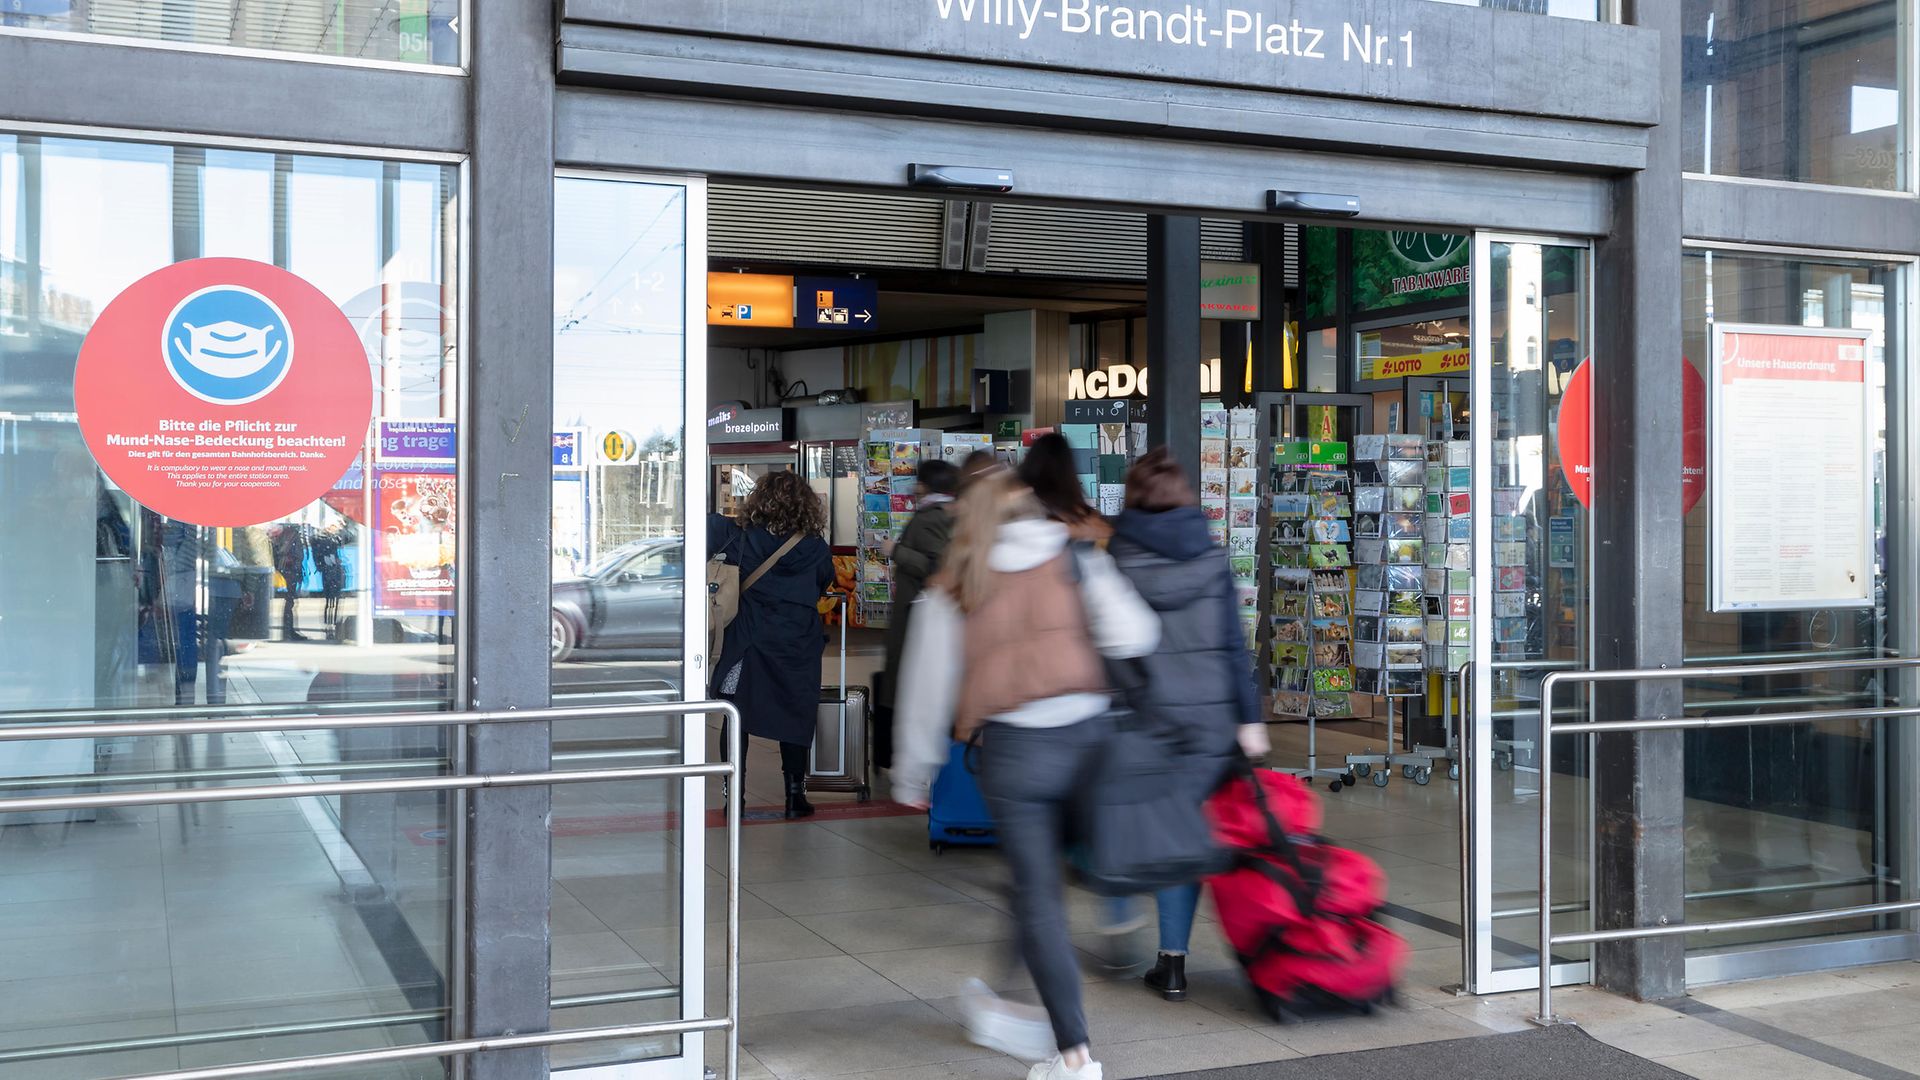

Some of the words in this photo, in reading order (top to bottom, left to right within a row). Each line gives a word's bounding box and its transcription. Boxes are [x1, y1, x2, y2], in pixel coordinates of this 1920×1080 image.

[935, 0, 1325, 58] Willy-Brandt-Platz
[1343, 22, 1412, 67] Nr.1
[1392, 265, 1470, 294] TABAKWARE
[1393, 359, 1422, 373] LOTTO
[1453, 353, 1470, 366] LOT
[1737, 357, 1771, 369] Unsere
[1772, 359, 1836, 373] Hausordnung
[1075, 406, 1119, 417] FINO
[159, 419, 195, 431] Bitte
[198, 420, 221, 432] die
[225, 420, 271, 432] Pflicht
[274, 423, 297, 432] zur
[725, 421, 779, 434] brezelpoint
[106, 434, 274, 449] Mund-Nase-Bedeckung
[277, 435, 346, 447] beachten!
[128, 450, 146, 458] Dies
[147, 450, 161, 459] gilt
[162, 450, 174, 458] für
[175, 450, 191, 458] den
[192, 451, 230, 459] gesamten
[231, 451, 298, 459] Bahnhofsbereich.
[299, 451, 326, 459] Danke.
[160, 464, 200, 472] compulsory
[181, 472, 206, 480] applies
[212, 480, 222, 488] for
